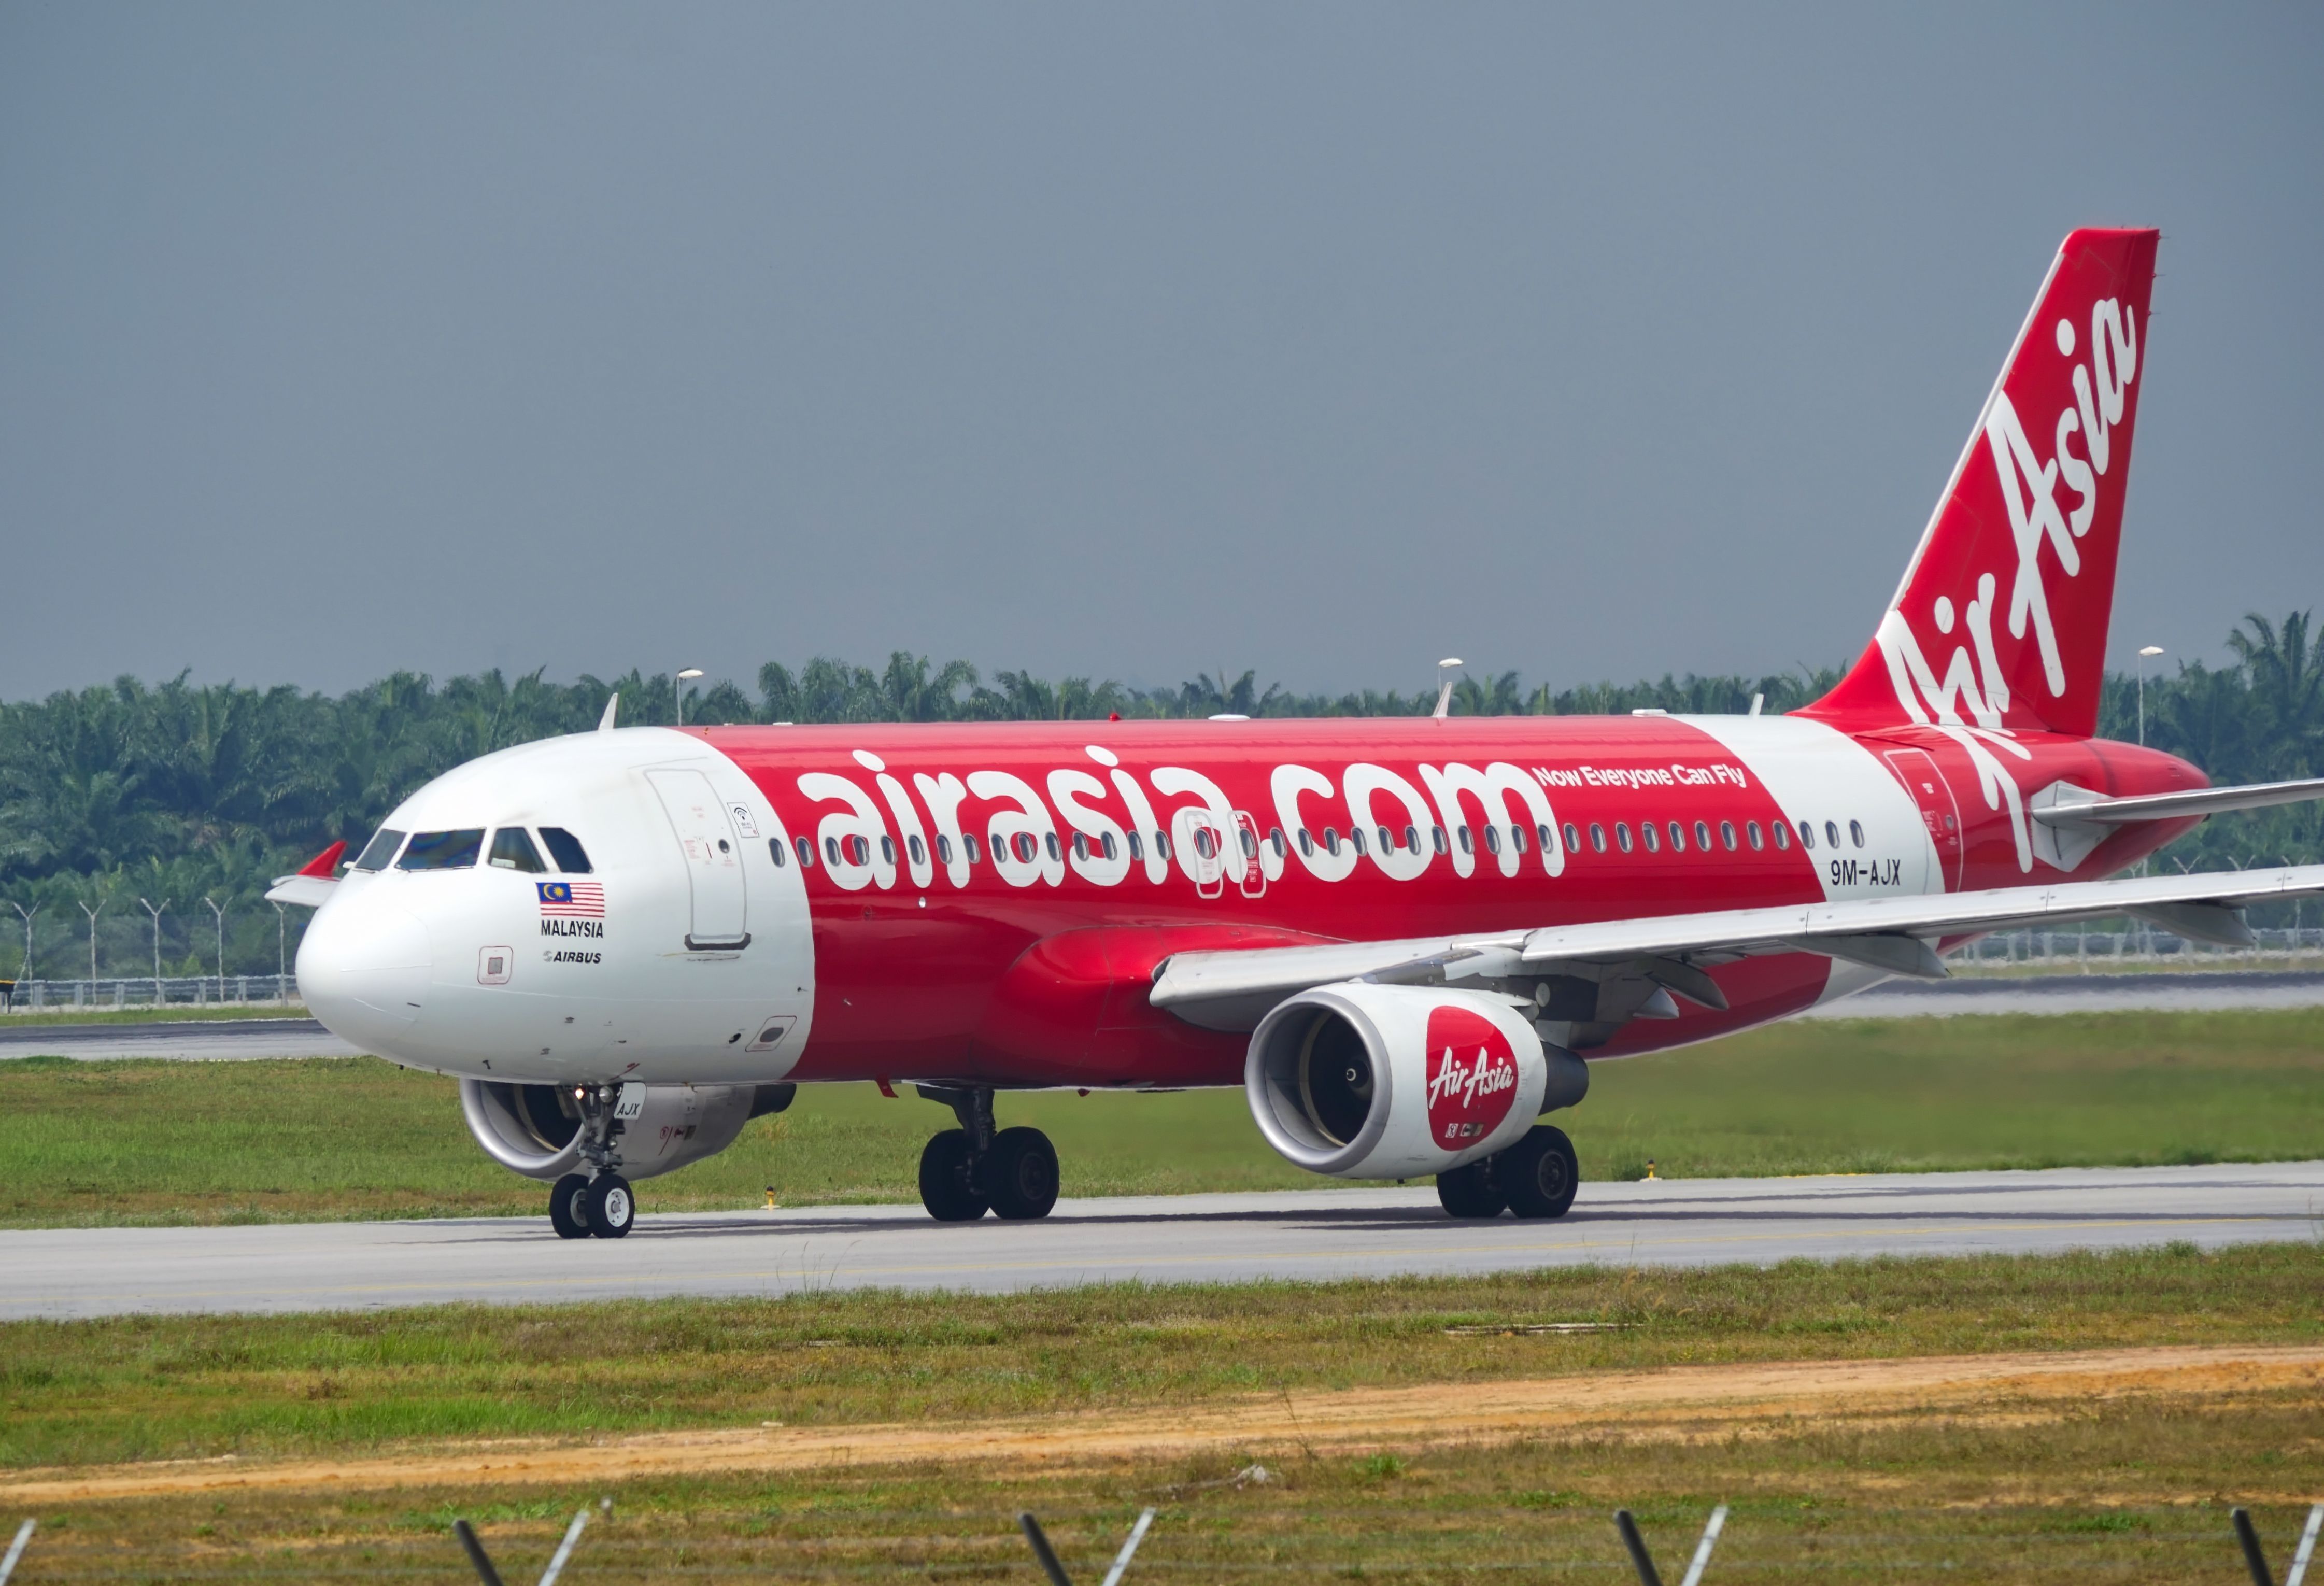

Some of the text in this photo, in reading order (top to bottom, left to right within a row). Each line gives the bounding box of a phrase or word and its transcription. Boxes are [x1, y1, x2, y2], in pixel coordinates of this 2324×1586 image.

[1532, 763, 1747, 789] Now Everyone Can Fly
[797, 745, 1565, 890] airasia.com
[1831, 858, 1901, 886] 9M-AJX
[541, 919, 603, 938] MALAYSIA
[553, 951, 602, 964] AIRBUS
[617, 1102, 640, 1115] AJX
